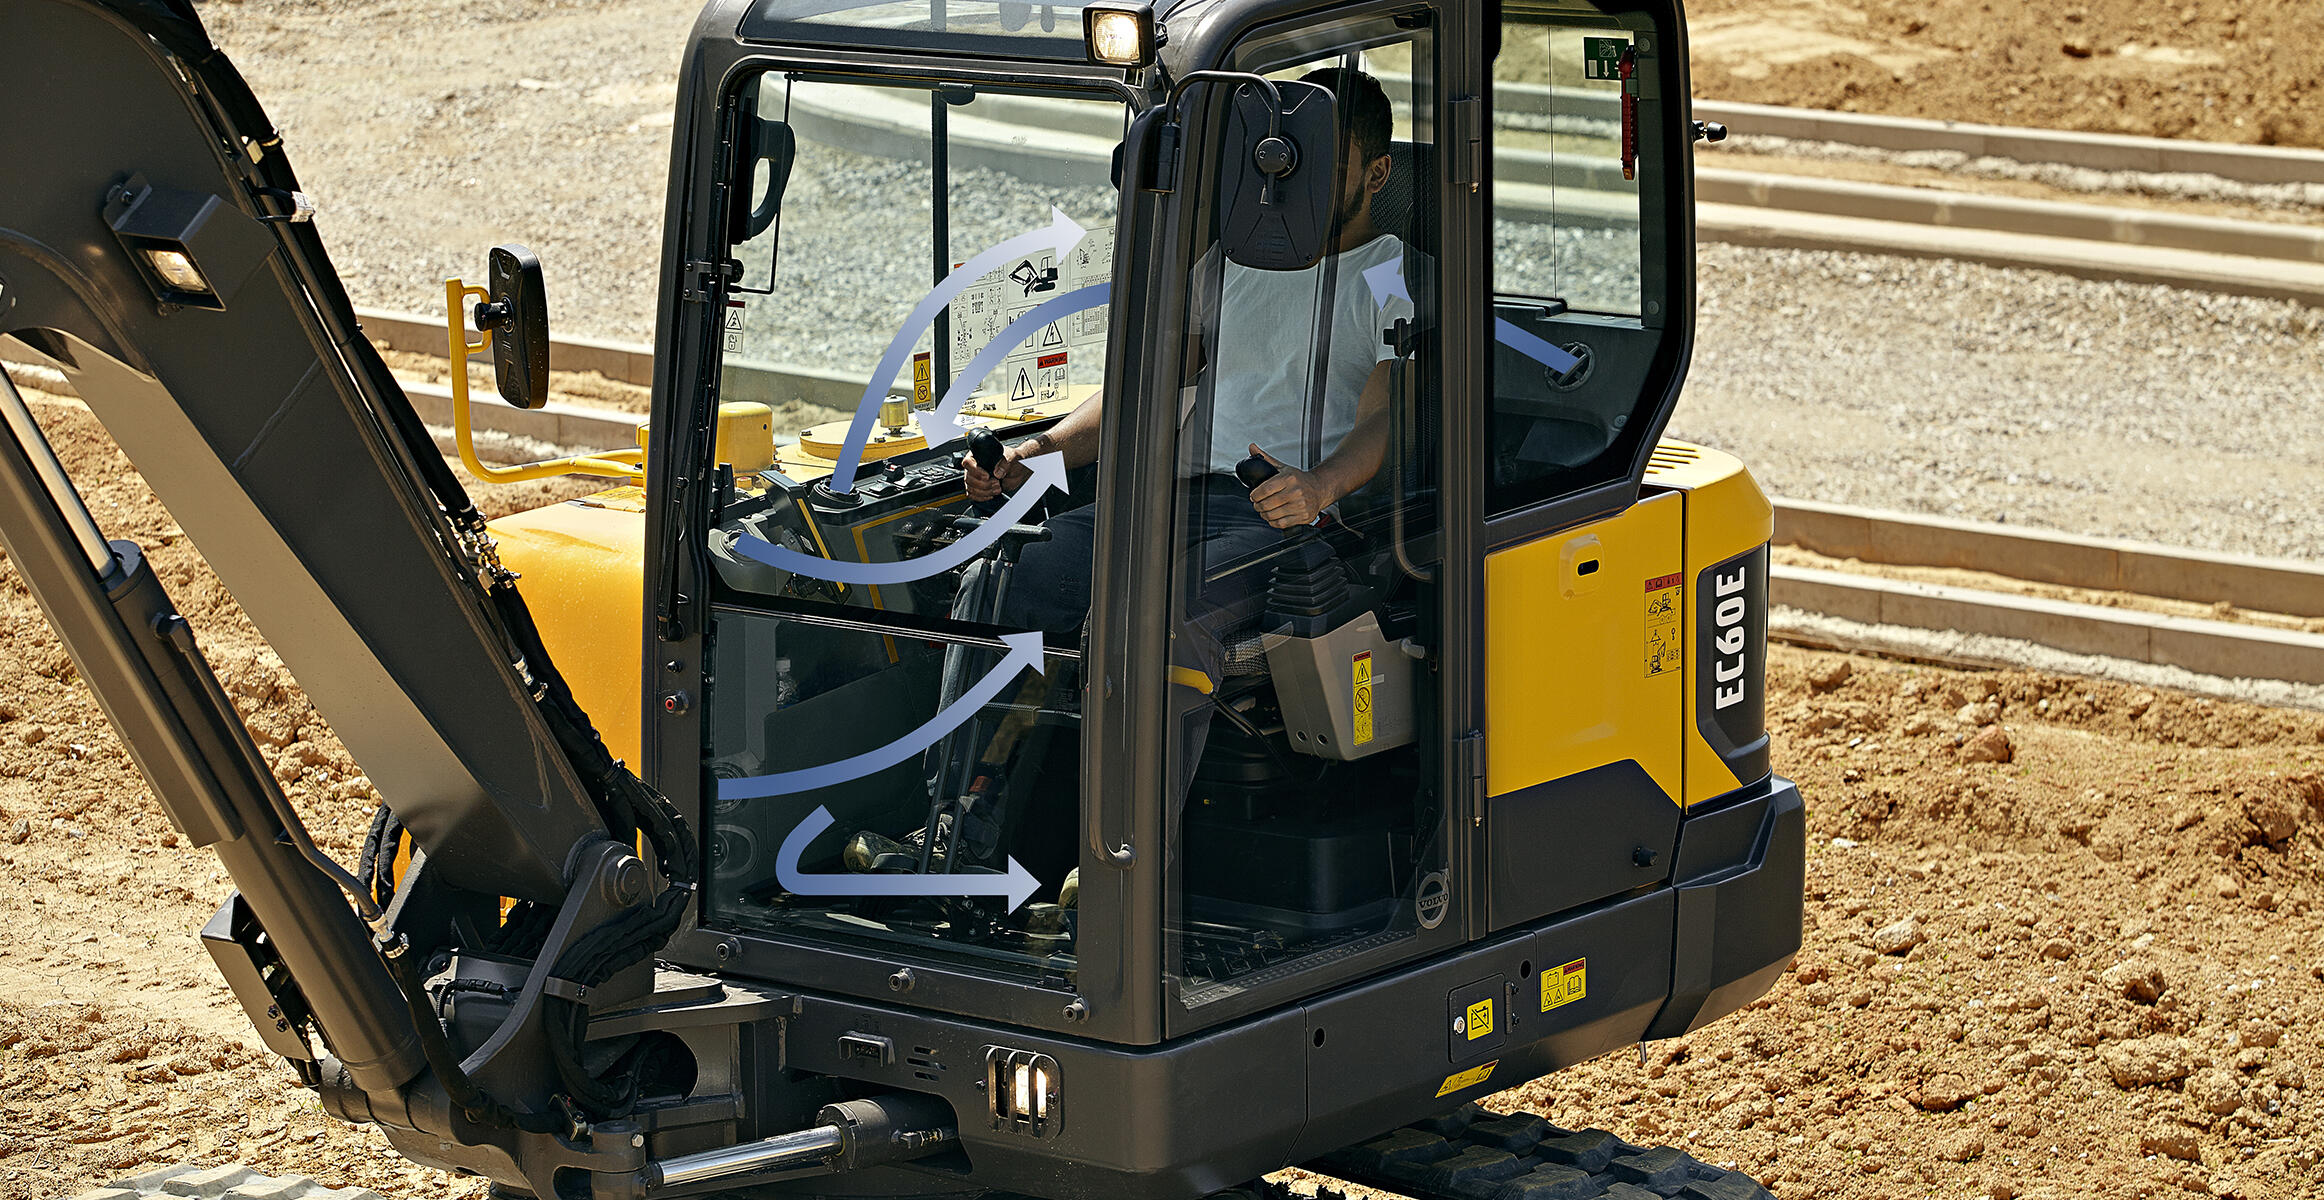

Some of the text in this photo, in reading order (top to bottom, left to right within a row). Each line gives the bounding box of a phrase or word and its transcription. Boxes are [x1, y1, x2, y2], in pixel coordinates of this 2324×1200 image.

[1044, 355, 1066, 364] WARNING
[1716, 566, 1745, 710] EC60E
[1419, 893, 1448, 907] VOLVO
